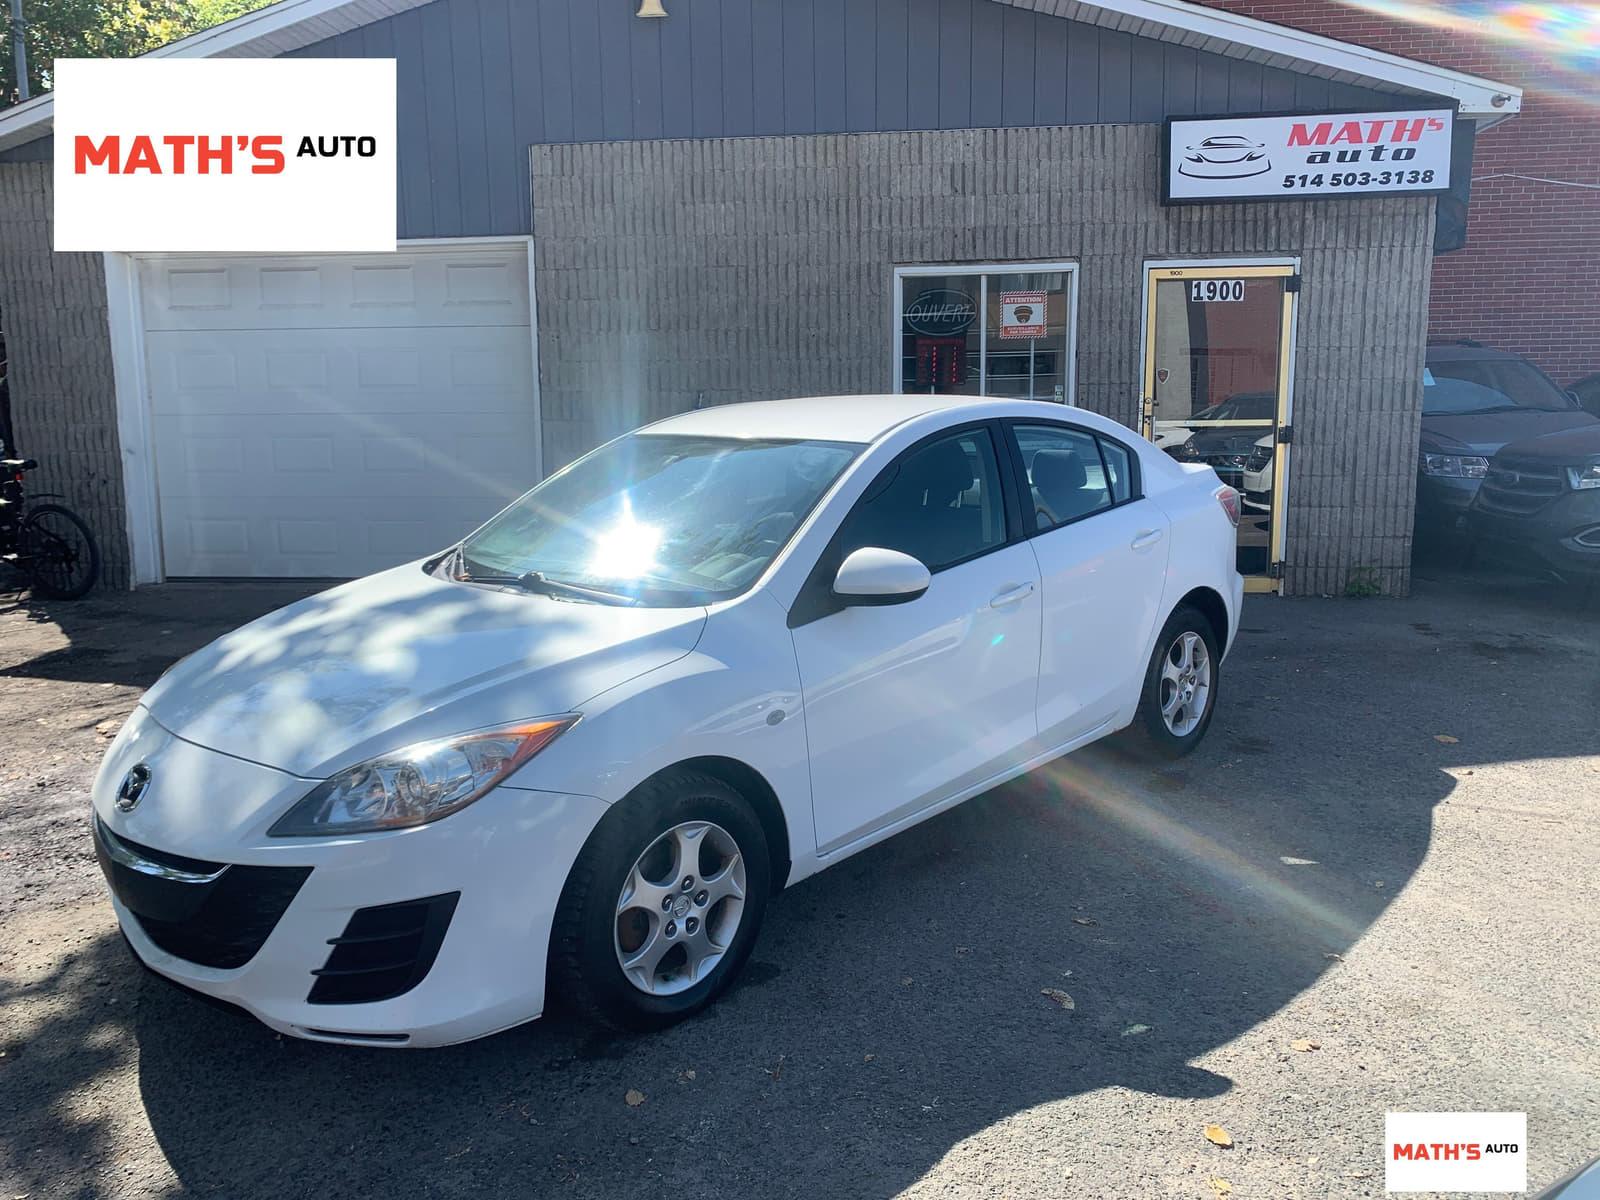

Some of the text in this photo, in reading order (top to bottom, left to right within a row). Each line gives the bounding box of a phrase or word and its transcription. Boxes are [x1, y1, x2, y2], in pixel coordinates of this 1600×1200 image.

[1306, 144, 1416, 164] auto
[1282, 169, 1435, 188] 514 503-3138
[1005, 296, 1042, 304] ATTENTION
[1193, 281, 1243, 301] 1900
[910, 303, 972, 323] OUVERT
